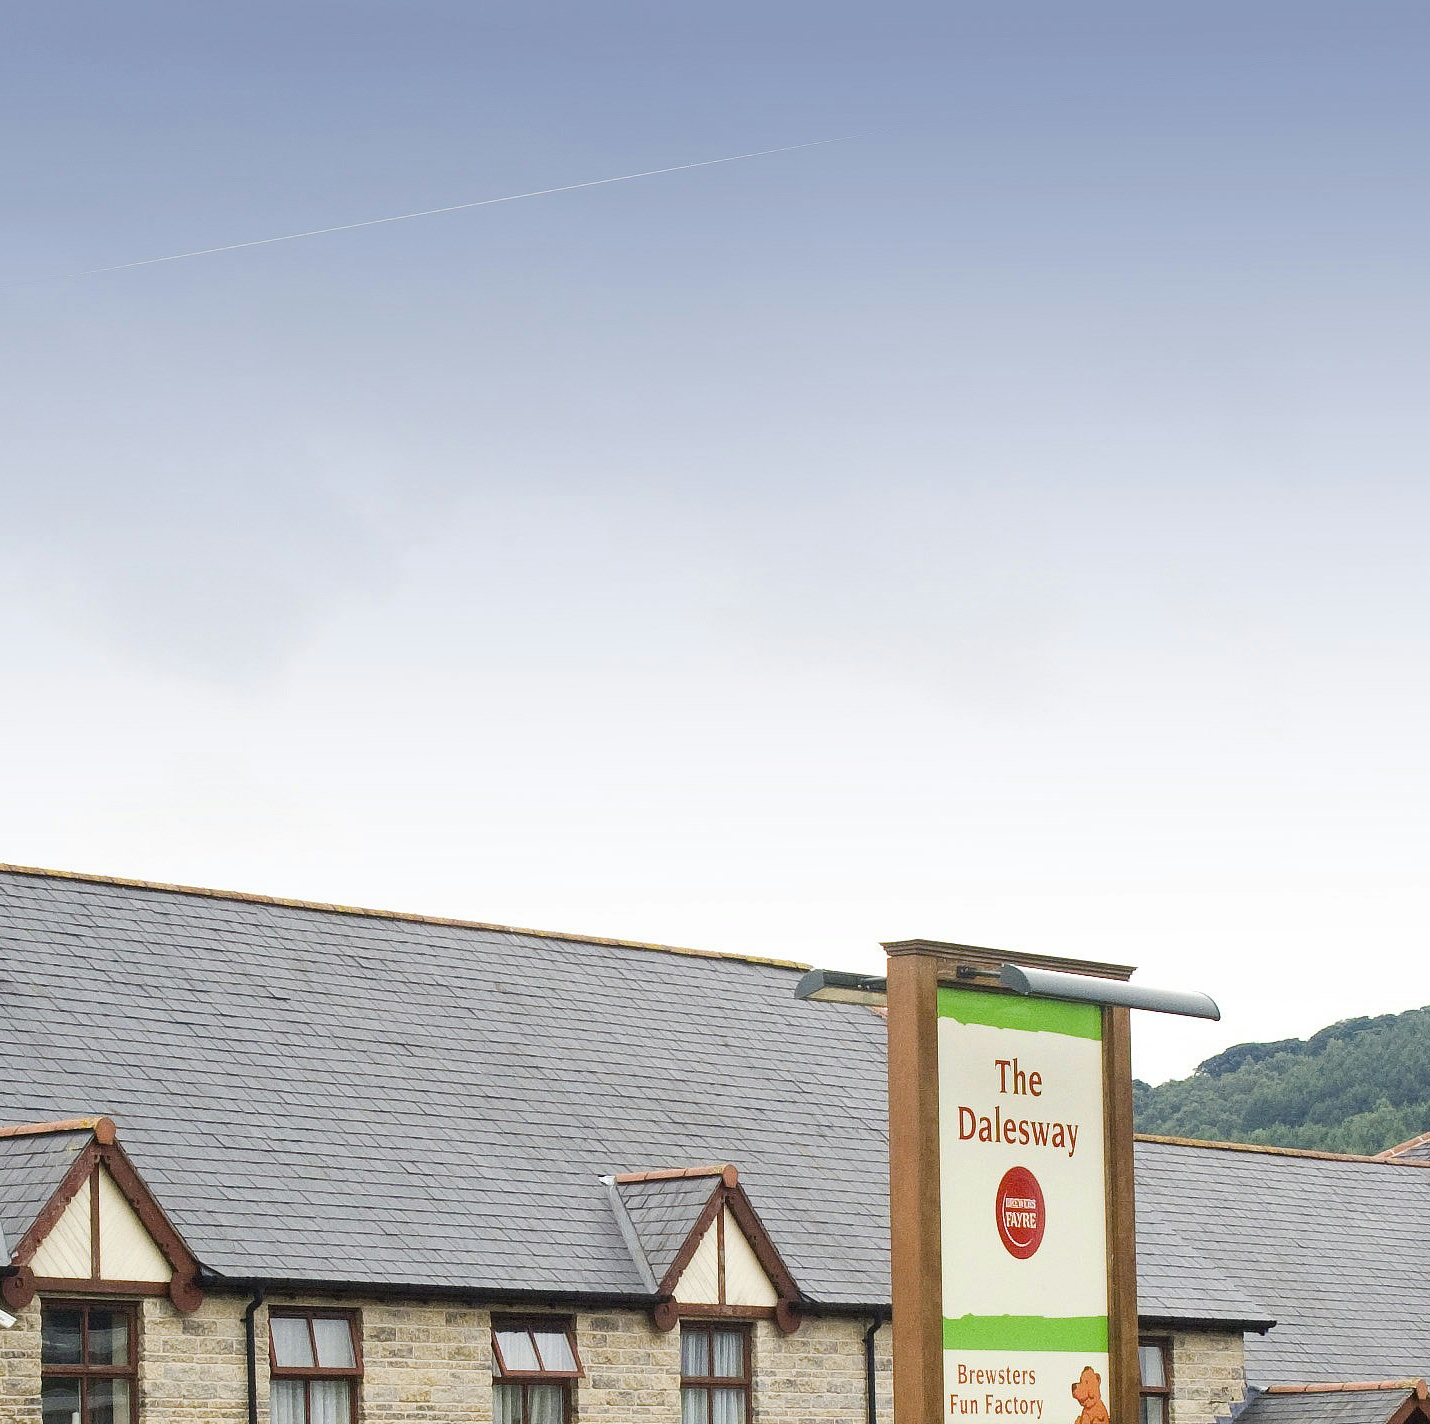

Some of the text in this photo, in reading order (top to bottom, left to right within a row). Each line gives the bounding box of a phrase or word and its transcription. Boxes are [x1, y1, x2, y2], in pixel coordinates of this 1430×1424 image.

[995, 1059, 1043, 1097] The
[958, 1106, 1079, 1157] Dalesway
[1005, 1211, 1037, 1229] FAYRE
[957, 1363, 1036, 1386] Brewsters
[950, 1393, 1044, 1420] Fun Factory
